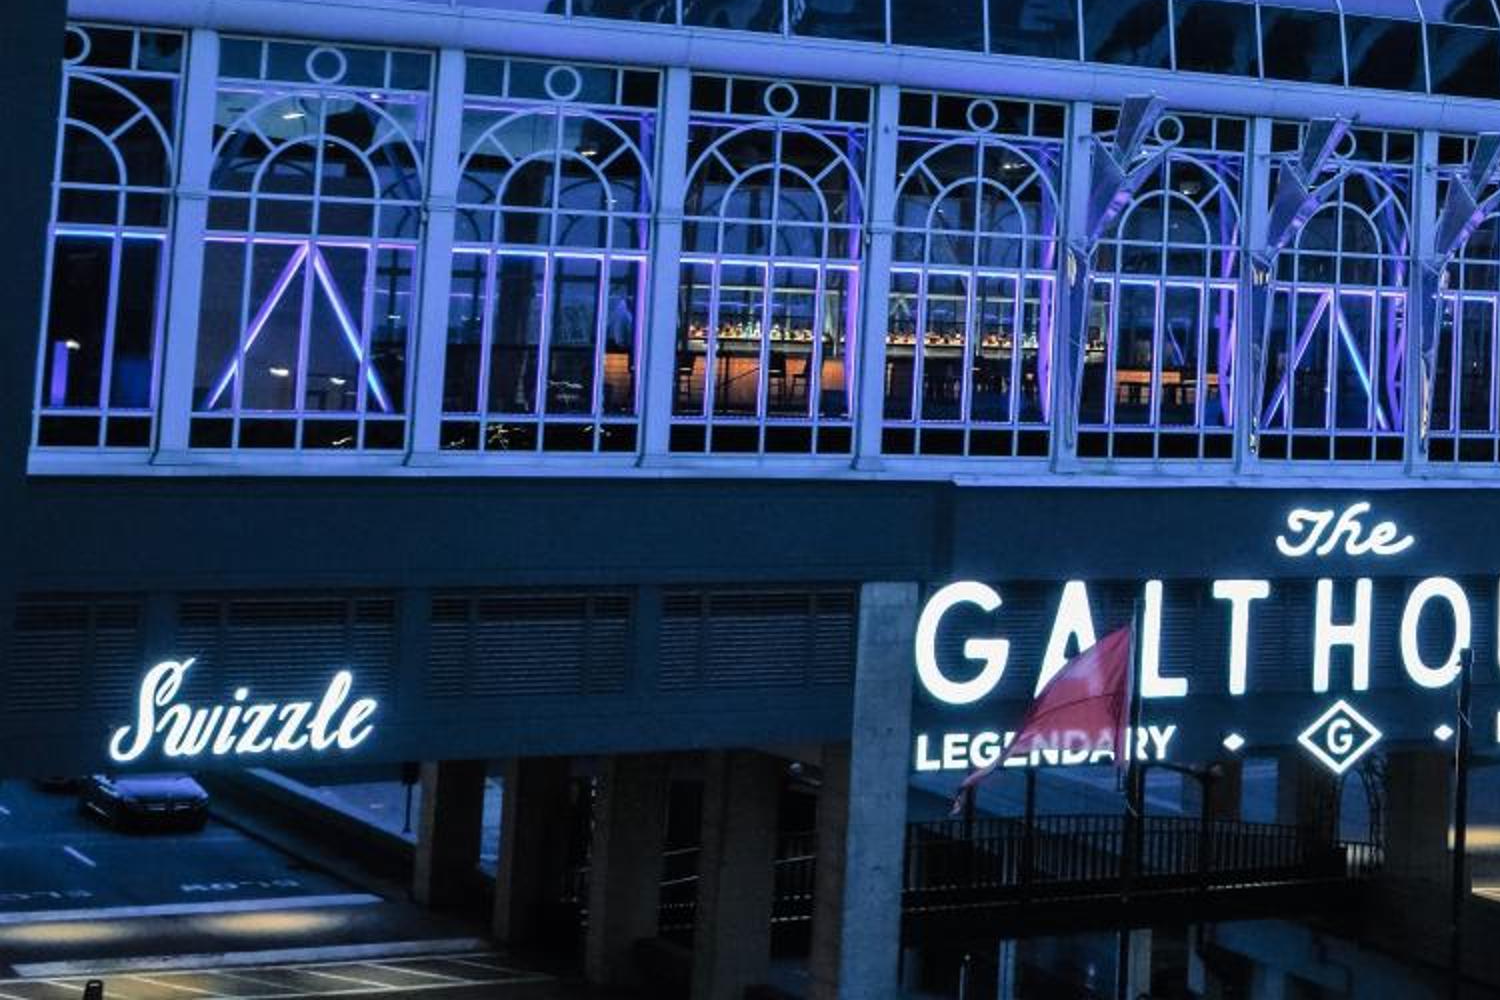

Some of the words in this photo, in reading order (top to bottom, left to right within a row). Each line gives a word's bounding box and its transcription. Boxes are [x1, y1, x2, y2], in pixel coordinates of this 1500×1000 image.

[1275, 501, 1415, 557] The
[915, 578, 1270, 705] GALT
[109, 657, 378, 762] Swizzle
[1326, 718, 1353, 755] G
